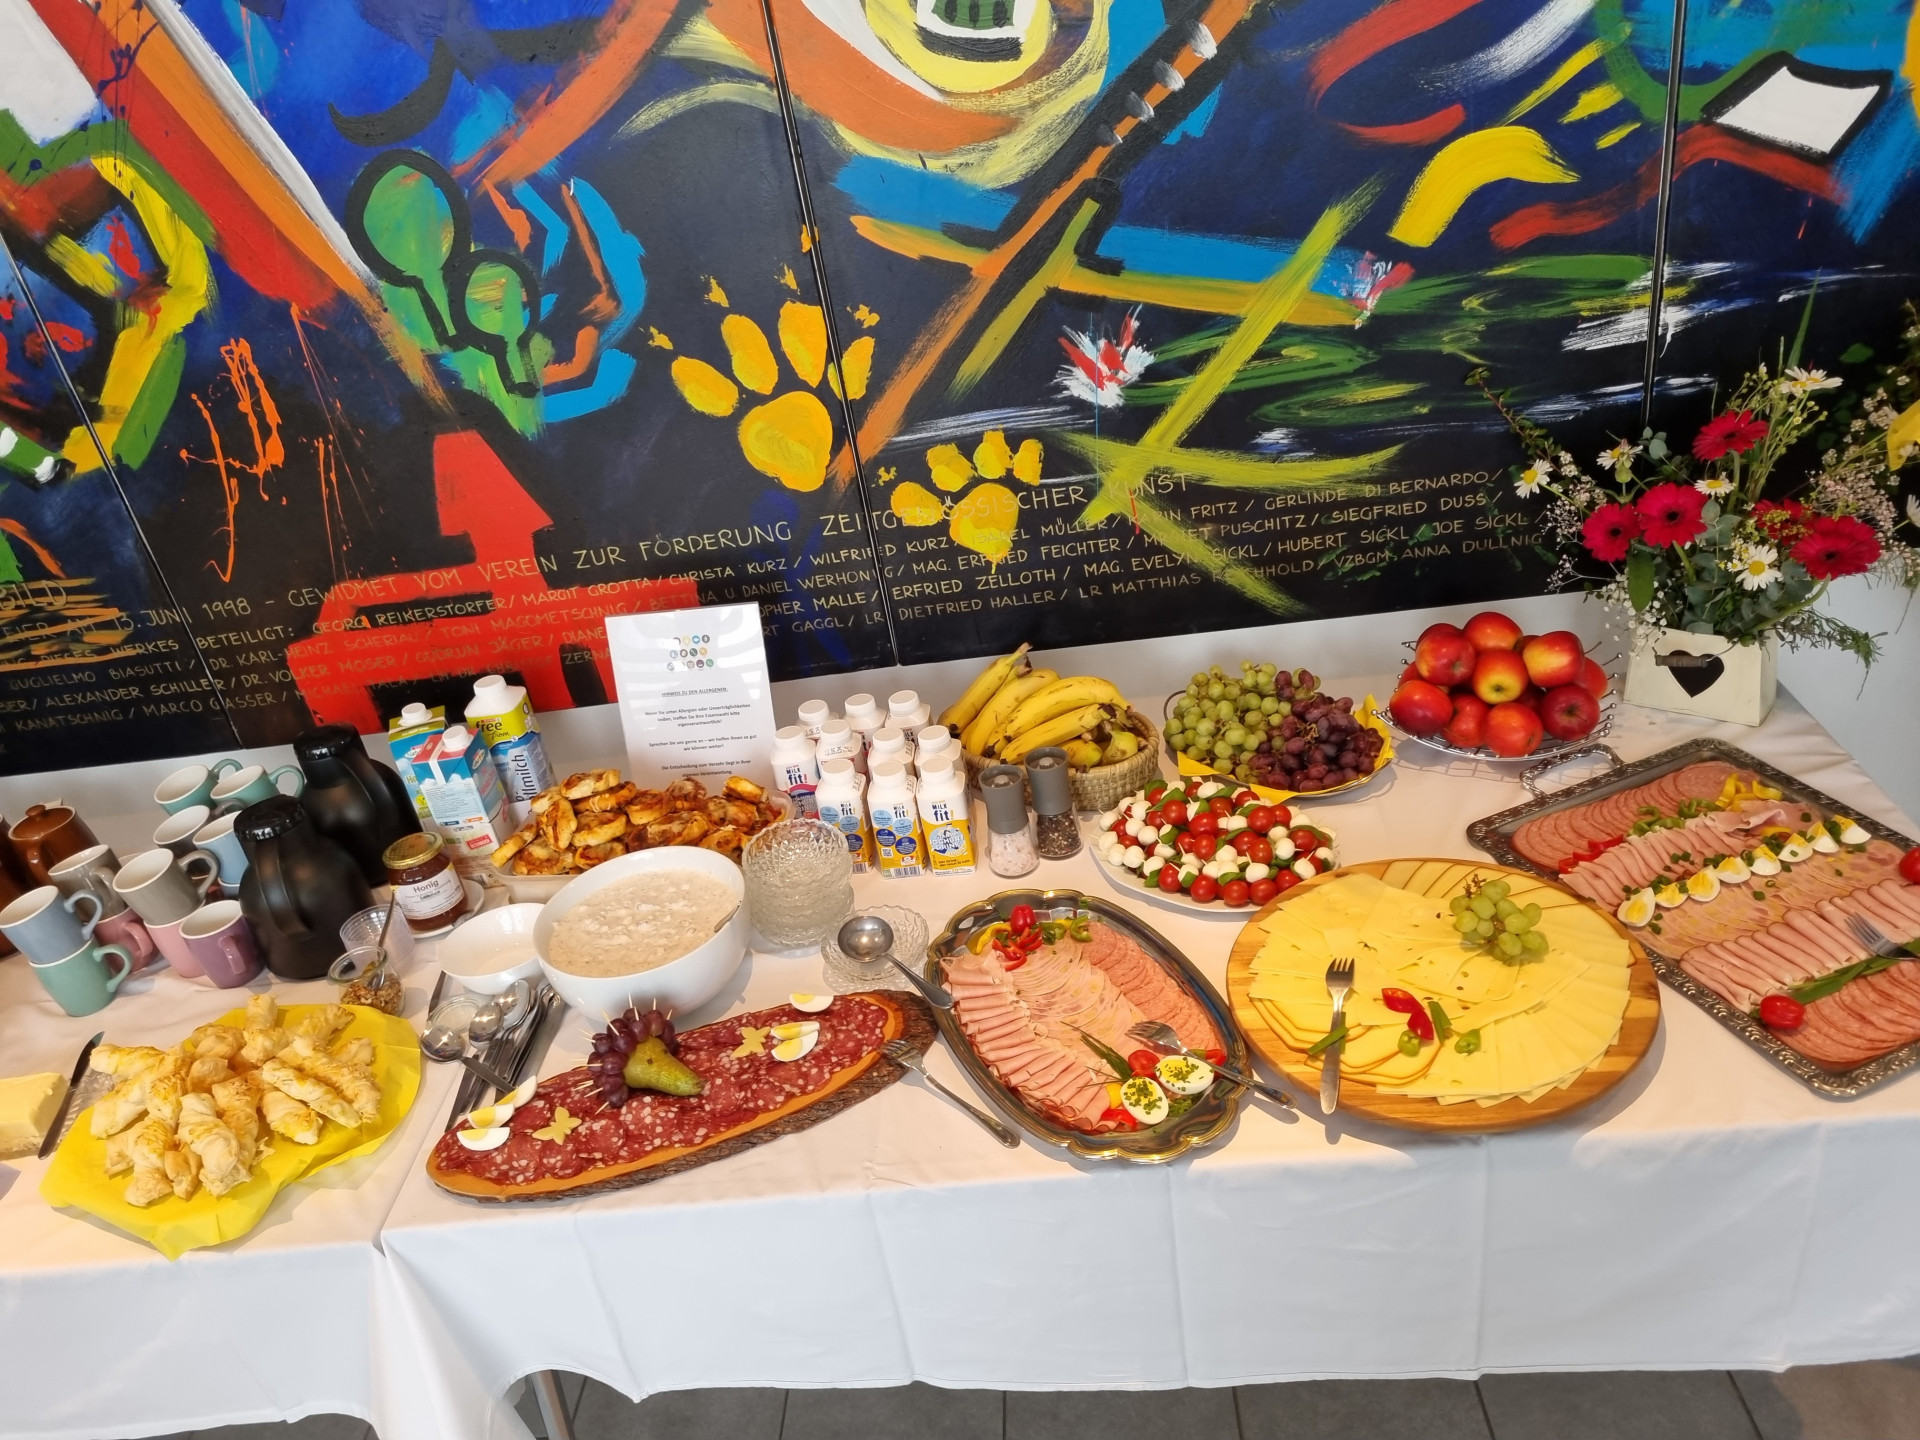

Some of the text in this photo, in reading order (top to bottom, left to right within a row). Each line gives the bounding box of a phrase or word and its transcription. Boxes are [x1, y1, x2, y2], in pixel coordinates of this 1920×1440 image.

[46, 686, 145, 707] ALEXANDER
[150, 678, 227, 696] SCHILLER
[269, 664, 331, 683] VOLKER
[339, 655, 399, 674] MOSER
[813, 592, 866, 611] MALLE
[892, 579, 963, 600] ERFRIED
[975, 568, 1056, 590] ZELLOTH
[1084, 560, 1124, 578] MAG.
[1212, 544, 1260, 560] SICKL
[1278, 532, 1348, 553] HUBERT
[1360, 526, 1410, 544] SICKL
[1432, 519, 1465, 536] JOE
[1475, 512, 1529, 530] SICKL
[108, 661, 181, 681] BIASUTTI
[650, 591, 717, 611] BETTINA
[742, 580, 793, 597] DANIEL
[912, 559, 952, 576] MAG.
[1041, 538, 1121, 561] FEICHTER
[1221, 515, 1307, 537] PUSCHITZ
[1331, 501, 1428, 524] SIEGFRIED
[1441, 493, 1487, 511] DUSS
[196, 625, 294, 649] BETEILIGT:
[522, 586, 580, 606] MARGIT
[588, 577, 651, 597] GROTTA
[669, 566, 735, 585] CHRISTA
[747, 558, 788, 574] KURZ
[810, 544, 897, 566] WILFRIED
[906, 537, 949, 554] KURZ
[1041, 516, 1108, 538] MÜLLER
[1190, 501, 1238, 519] FRITZ
[1264, 488, 1348, 511] GERLINDE
[1365, 484, 1381, 497] DI
[202, 598, 251, 620] 1998
[288, 576, 398, 607] GEWIDMET
[414, 567, 463, 591] VOM
[478, 554, 558, 583] VEREIN
[573, 546, 626, 569] ZUR
[639, 521, 792, 561] FÖRDERUNG
[1108, 472, 1191, 499] KUNST
[142, 699, 203, 716] MARCO
[791, 616, 845, 633] GAGGL
[864, 611, 885, 625] LR
[898, 599, 983, 621] DIETFRIED
[991, 590, 1056, 608] HALLER
[1078, 585, 1102, 599] LR
[1112, 572, 1201, 594] MATTHIAS
[1400, 543, 1451, 560] ANNA
[1462, 533, 1543, 554] DULLNIG
[476, 720, 503, 732] free
[413, 880, 440, 893] Honig
[934, 809, 955, 822] fit!
